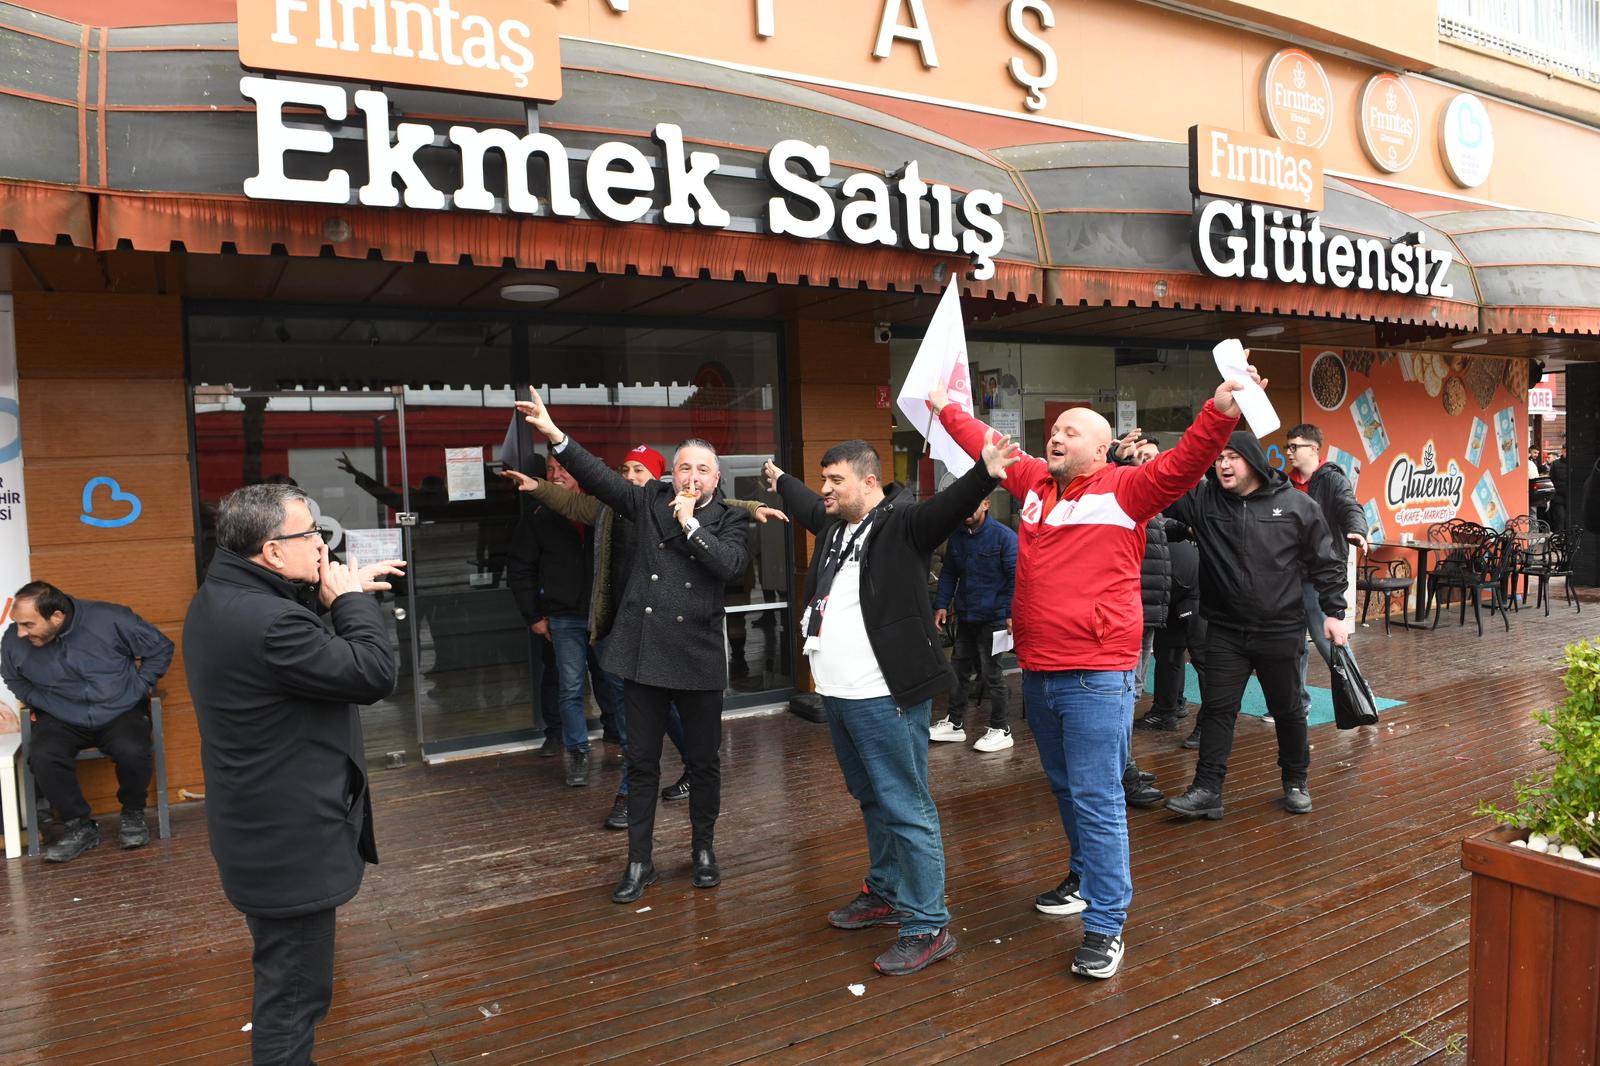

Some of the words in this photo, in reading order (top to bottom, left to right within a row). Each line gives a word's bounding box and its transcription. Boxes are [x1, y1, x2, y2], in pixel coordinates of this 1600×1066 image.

[240, 76, 731, 230] Ekmek
[768, 139, 1005, 281] Satış
[1210, 130, 1313, 203] Fırıntaş
[1198, 200, 1454, 298] Glütensiz
